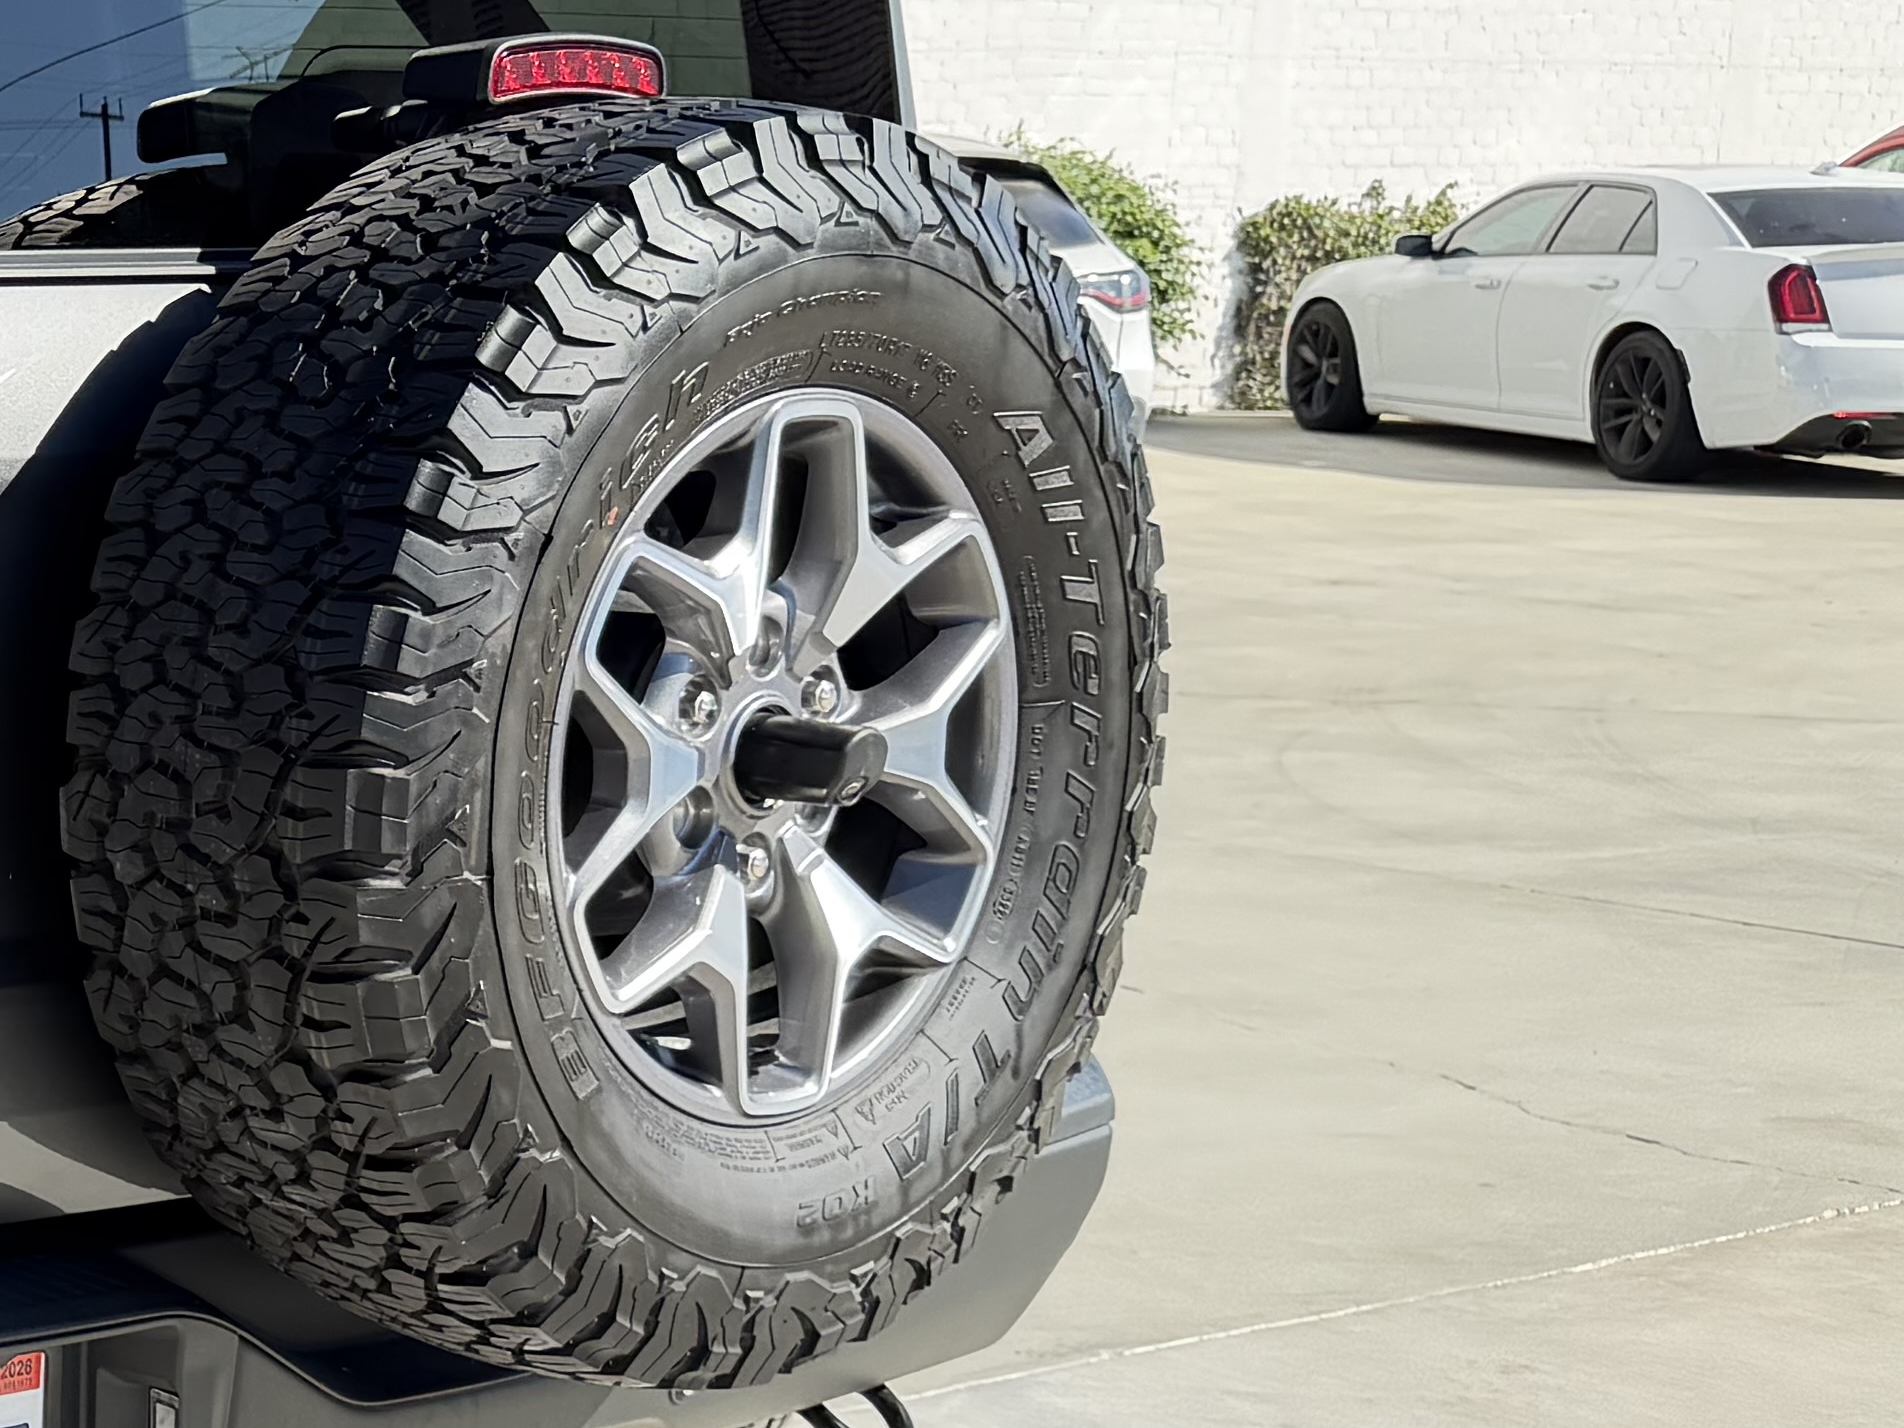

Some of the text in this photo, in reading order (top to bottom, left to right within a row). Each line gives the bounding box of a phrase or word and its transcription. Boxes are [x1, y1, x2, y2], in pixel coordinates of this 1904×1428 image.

[514, 360, 710, 1101] BFGoodrich
[993, 410, 1105, 1022] All-Terrain
[881, 1029, 1013, 1182] T/A
